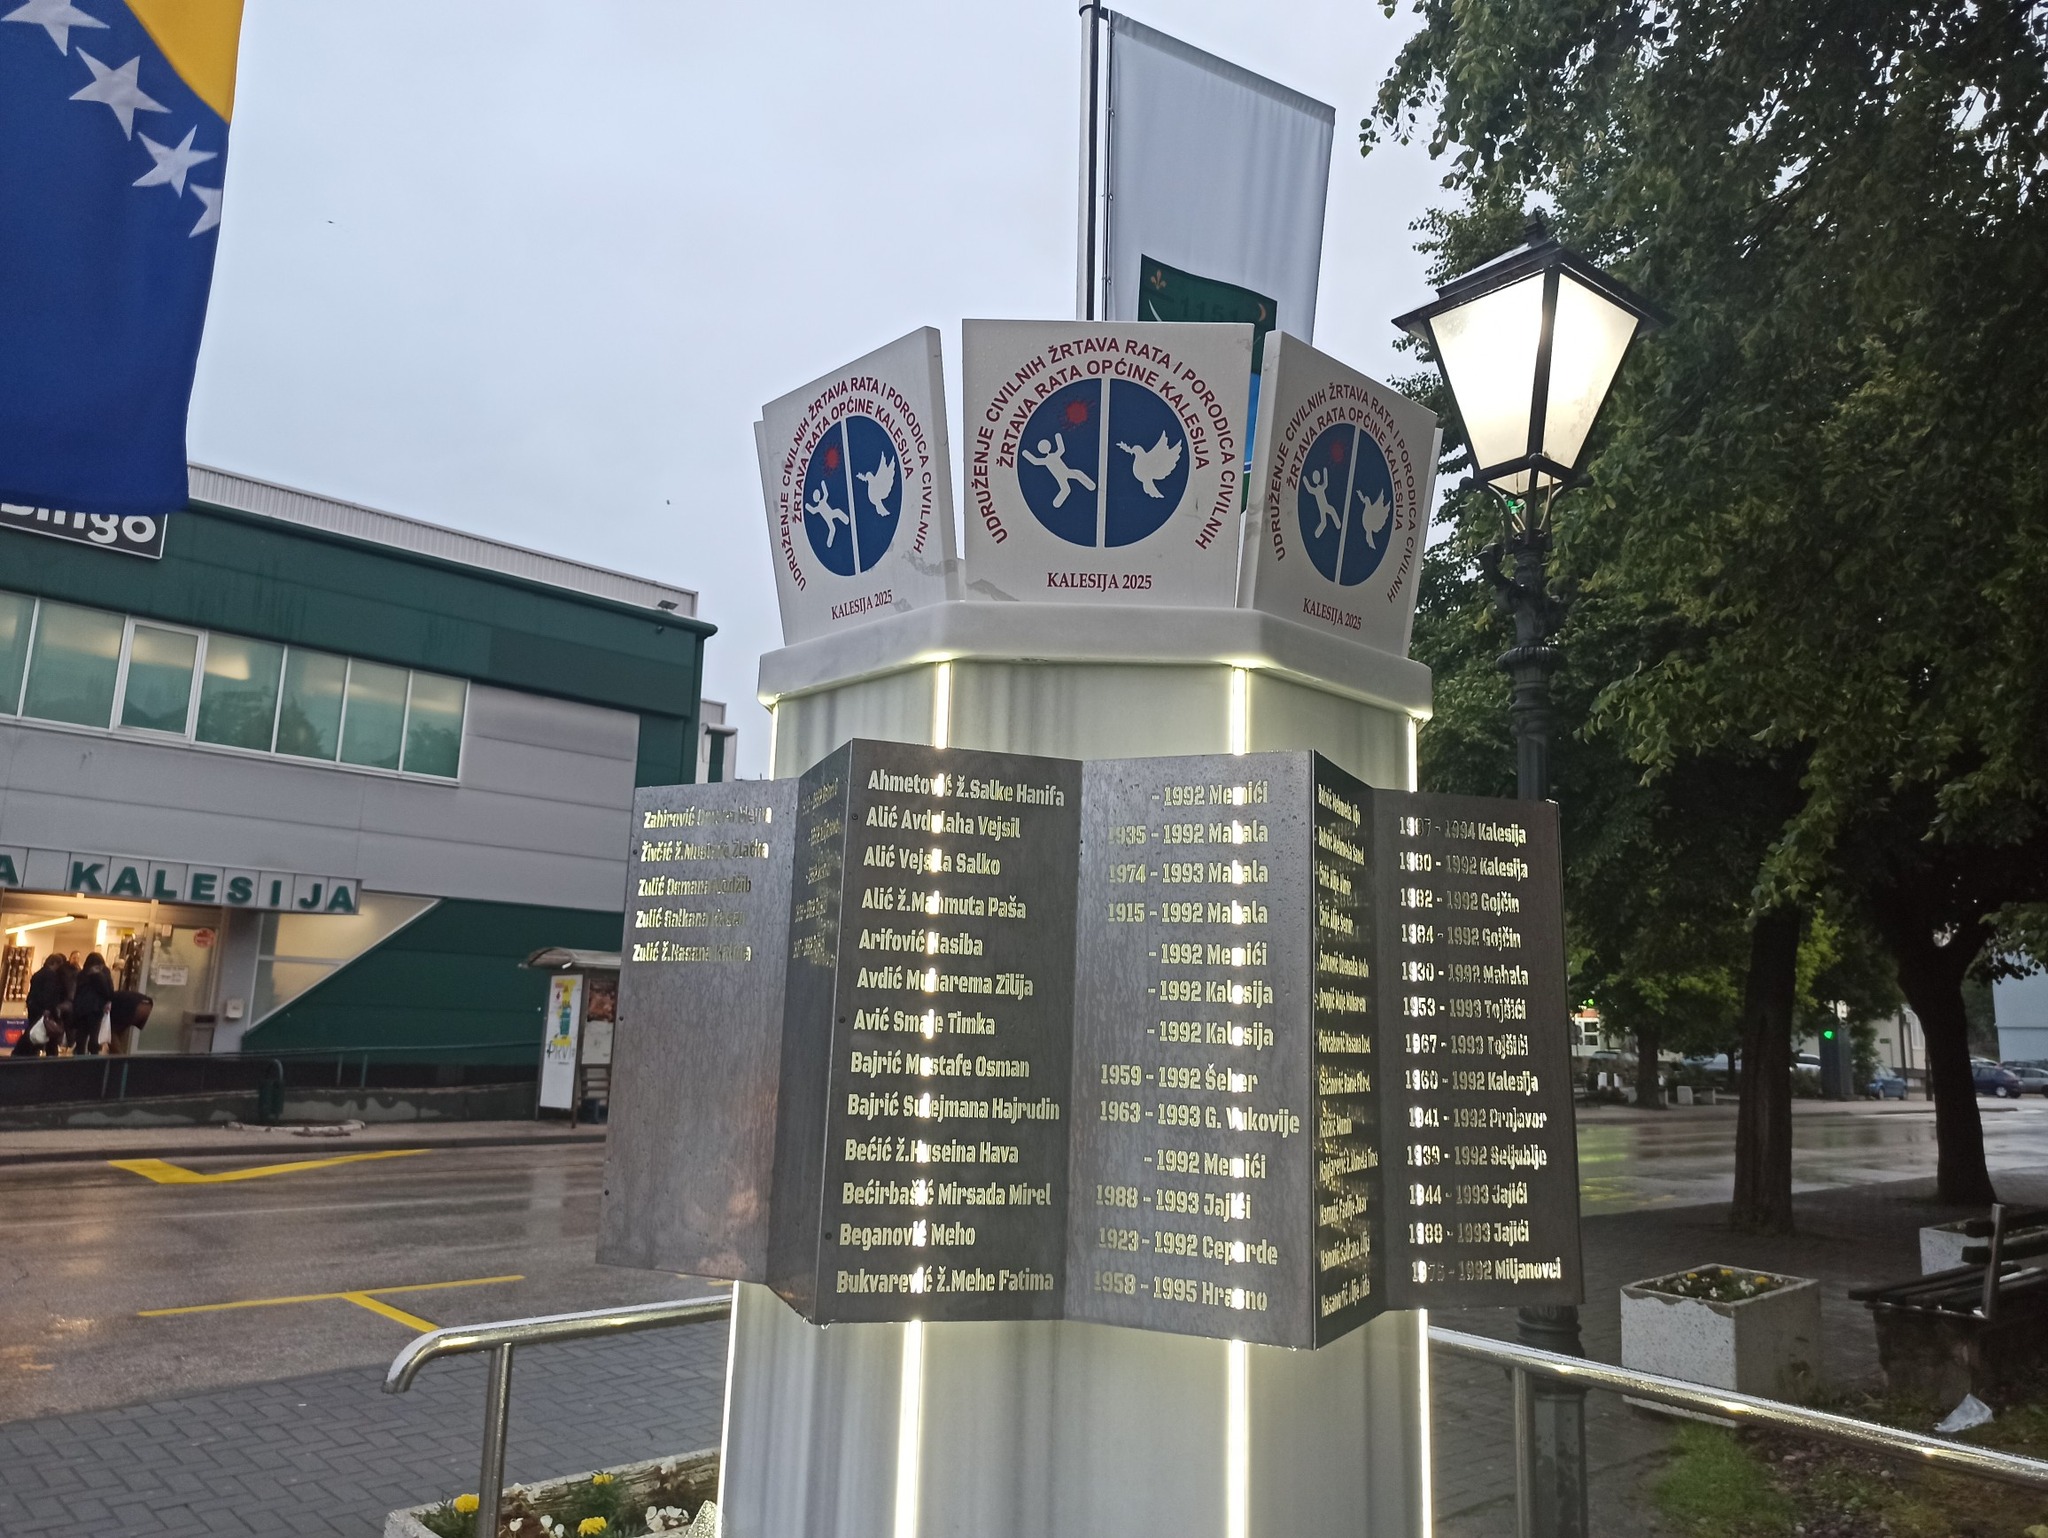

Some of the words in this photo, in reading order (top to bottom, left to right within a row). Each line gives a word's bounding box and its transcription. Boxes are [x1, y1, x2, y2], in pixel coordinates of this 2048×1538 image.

[1047, 337, 1120, 364] ŽRTAVA
[1125, 340, 1173, 369] RATA
[1173, 361, 1183, 374] I
[851, 376, 879, 396] RATA
[881, 383, 887, 396] I
[986, 356, 1047, 422] CIVILNIH
[1328, 382, 1369, 406] ŽRTAVA
[808, 381, 848, 421] ŽRTAVA
[996, 398, 1038, 468] ŽRTAVA
[1035, 365, 1082, 396] RATA
[1086, 358, 1159, 387] OPĆINE
[1159, 381, 1210, 470] KALESIJA
[1371, 397, 1394, 432] RATA
[886, 387, 929, 468] PORODICA
[1181, 368, 1236, 465] PORODICA
[1285, 392, 1327, 443] CIVILNIH
[1394, 429, 1400, 440] I
[782, 418, 809, 486] CIVILNIH
[792, 457, 809, 523] ŽRTAVA
[805, 419, 830, 455] RATA
[831, 396, 873, 419] OPĆINE
[874, 404, 914, 480] KALESIJA
[1286, 426, 1318, 491] ŽRTAVA
[1317, 406, 1345, 431] RATA
[1349, 407, 1385, 444] OPĆINE
[1383, 444, 1403, 530] KALESIJA
[971, 426, 1008, 544] UDRUŽENJE
[1397, 440, 1416, 532] PORODICA
[913, 472, 932, 554] CIVILNIH
[1195, 470, 1236, 550] CIVILNIH
[1268, 442, 1289, 562] UDRUŽENJE
[780, 492, 806, 591] UDRUŽENJE
[1047, 572, 1119, 592] KALESIJA
[1122, 575, 1152, 590] 2025
[1387, 539, 1415, 603] CIVILNIH
[831, 597, 873, 620] KALESIJA
[875, 590, 892, 608] 2025
[1303, 598, 1343, 625] KALESIJA
[1345, 612, 1362, 631] 2025
[868, 769, 952, 797] Ahmetović
[957, 775, 1013, 802] ž.Salke
[1016, 784, 1064, 806] Hanifa
[1164, 786, 1204, 806] 1992
[1209, 780, 1268, 806] Meići
[644, 806, 695, 828] Zahirović
[866, 806, 897, 827] Alić
[901, 810, 974, 835] Avdlaha
[978, 816, 1021, 841] Vejsil
[1164, 824, 1204, 844] 1992
[1209, 820, 1268, 844] Mahala
[1478, 822, 1526, 847] Kalesija
[641, 841, 673, 862] Živčić
[864, 845, 895, 867] Alić
[899, 848, 951, 874] Vejsla
[956, 854, 1000, 875] Salko
[1109, 864, 1146, 883] 1974
[1162, 863, 1203, 882] 1993
[1208, 860, 1268, 884] Mahala
[1480, 857, 1528, 881] Kalesija
[70, 862, 354, 912] KALESIJA
[638, 876, 665, 896] Zulić
[862, 887, 893, 909] Alić
[988, 895, 1026, 919] Paša
[1108, 903, 1144, 922] 1915
[1162, 902, 1202, 923] 1992
[1207, 900, 1267, 925] Mahala
[1481, 891, 1519, 916] Gojčin
[635, 907, 662, 928] Zulić
[633, 941, 659, 962] Zulić
[859, 929, 924, 953] Arifović
[1483, 926, 1520, 951] Gojčin
[1161, 943, 1202, 964] 1992
[1207, 942, 1266, 966] Meići
[857, 966, 902, 989] Avdić
[906, 968, 992, 994] Muharema
[1484, 964, 1529, 985] Mahala
[1160, 980, 1201, 1001] 1992
[1206, 980, 1273, 1008] Kalsija
[854, 1007, 889, 1030] Avić
[948, 1012, 995, 1035] Timka
[1403, 996, 1435, 1017] 1953
[1450, 999, 1481, 1018] 1993
[1485, 998, 1526, 1023] Tojšići
[1160, 1021, 1201, 1043] 1992
[1206, 1021, 1273, 1050] Kalsija
[1405, 1033, 1437, 1054] 1967
[1451, 1035, 1483, 1054] 1993
[851, 1050, 901, 1078] Bajrić
[906, 1053, 971, 1077] Mstafe
[975, 1056, 1029, 1077] Osman
[1101, 1064, 1141, 1086] 1959
[1159, 1066, 1201, 1089] 1992
[1453, 1071, 1485, 1090] 1992
[1488, 1070, 1539, 1096] Kalesija
[848, 1092, 899, 1120] Bajrić
[903, 1092, 988, 1123] Sulejmana
[992, 1098, 1060, 1124] Hajrudin
[1100, 1101, 1140, 1123] 1963
[1158, 1103, 1200, 1127] 1993
[1205, 1106, 1221, 1128] G.
[1226, 1107, 1300, 1138] Vukovije
[1454, 1109, 1486, 1127] 1992
[1490, 1107, 1547, 1132] Prnjavor
[845, 1136, 892, 1162] Bećić
[980, 1141, 1019, 1163] Hava
[1455, 1146, 1487, 1165] 1992
[1491, 1144, 1547, 1170] Seljublje
[1157, 1150, 1199, 1173] 1992
[1204, 1152, 1266, 1179] Meići
[843, 1179, 934, 1206] Bećirbašić
[938, 1183, 1005, 1205] Mirsada
[1009, 1183, 1051, 1205] Mirel
[1097, 1185, 1138, 1208] 1988
[1156, 1189, 1199, 1214] 1993
[1204, 1193, 1250, 1222] Jajići
[1409, 1184, 1441, 1206] 1944
[1492, 1182, 1527, 1208] Jajići
[840, 1219, 927, 1251] Beganović
[931, 1222, 975, 1246] Meho
[1099, 1228, 1138, 1251] 1923
[1155, 1230, 1198, 1256] 1992
[1202, 1236, 1277, 1265] Ceprde
[1409, 1223, 1442, 1244] 1988
[1494, 1220, 1529, 1247] Jajići
[837, 1266, 932, 1294] Bukvarević
[998, 1268, 1053, 1291] Fatima
[1495, 1257, 1561, 1284] Miljanovci
[1154, 1276, 1197, 1303] 1995
[1202, 1281, 1267, 1311] Hrano
